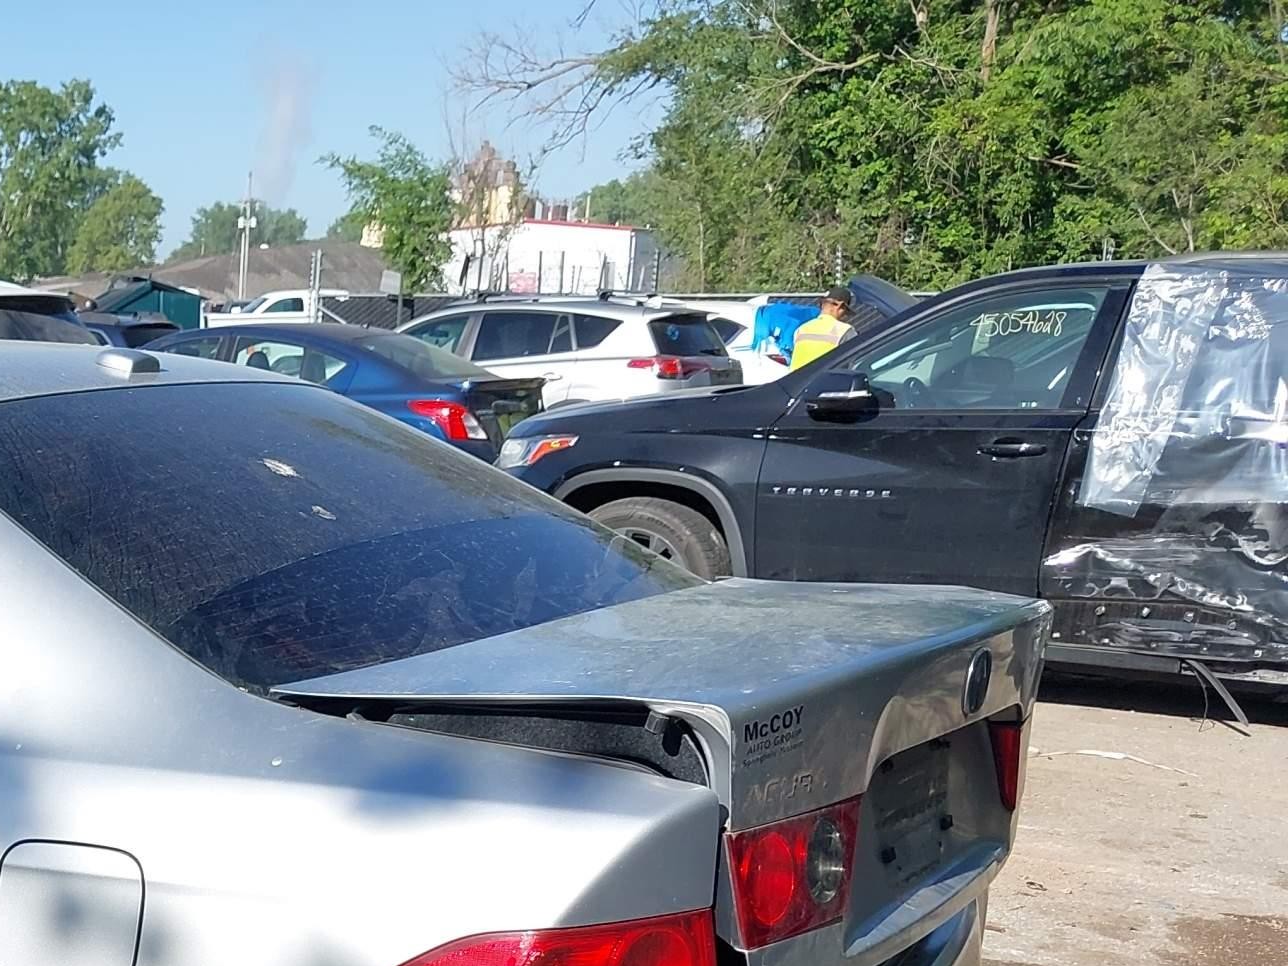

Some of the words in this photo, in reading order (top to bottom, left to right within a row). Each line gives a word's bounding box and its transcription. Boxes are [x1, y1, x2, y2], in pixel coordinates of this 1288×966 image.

[969, 310, 1067, 338] 45054628
[772, 486, 892, 498] TRAVERSE
[743, 705, 805, 744] McCOY
[746, 739, 771, 756] AUTO
[773, 728, 803, 747] GROUP
[747, 770, 827, 803] ACUR
